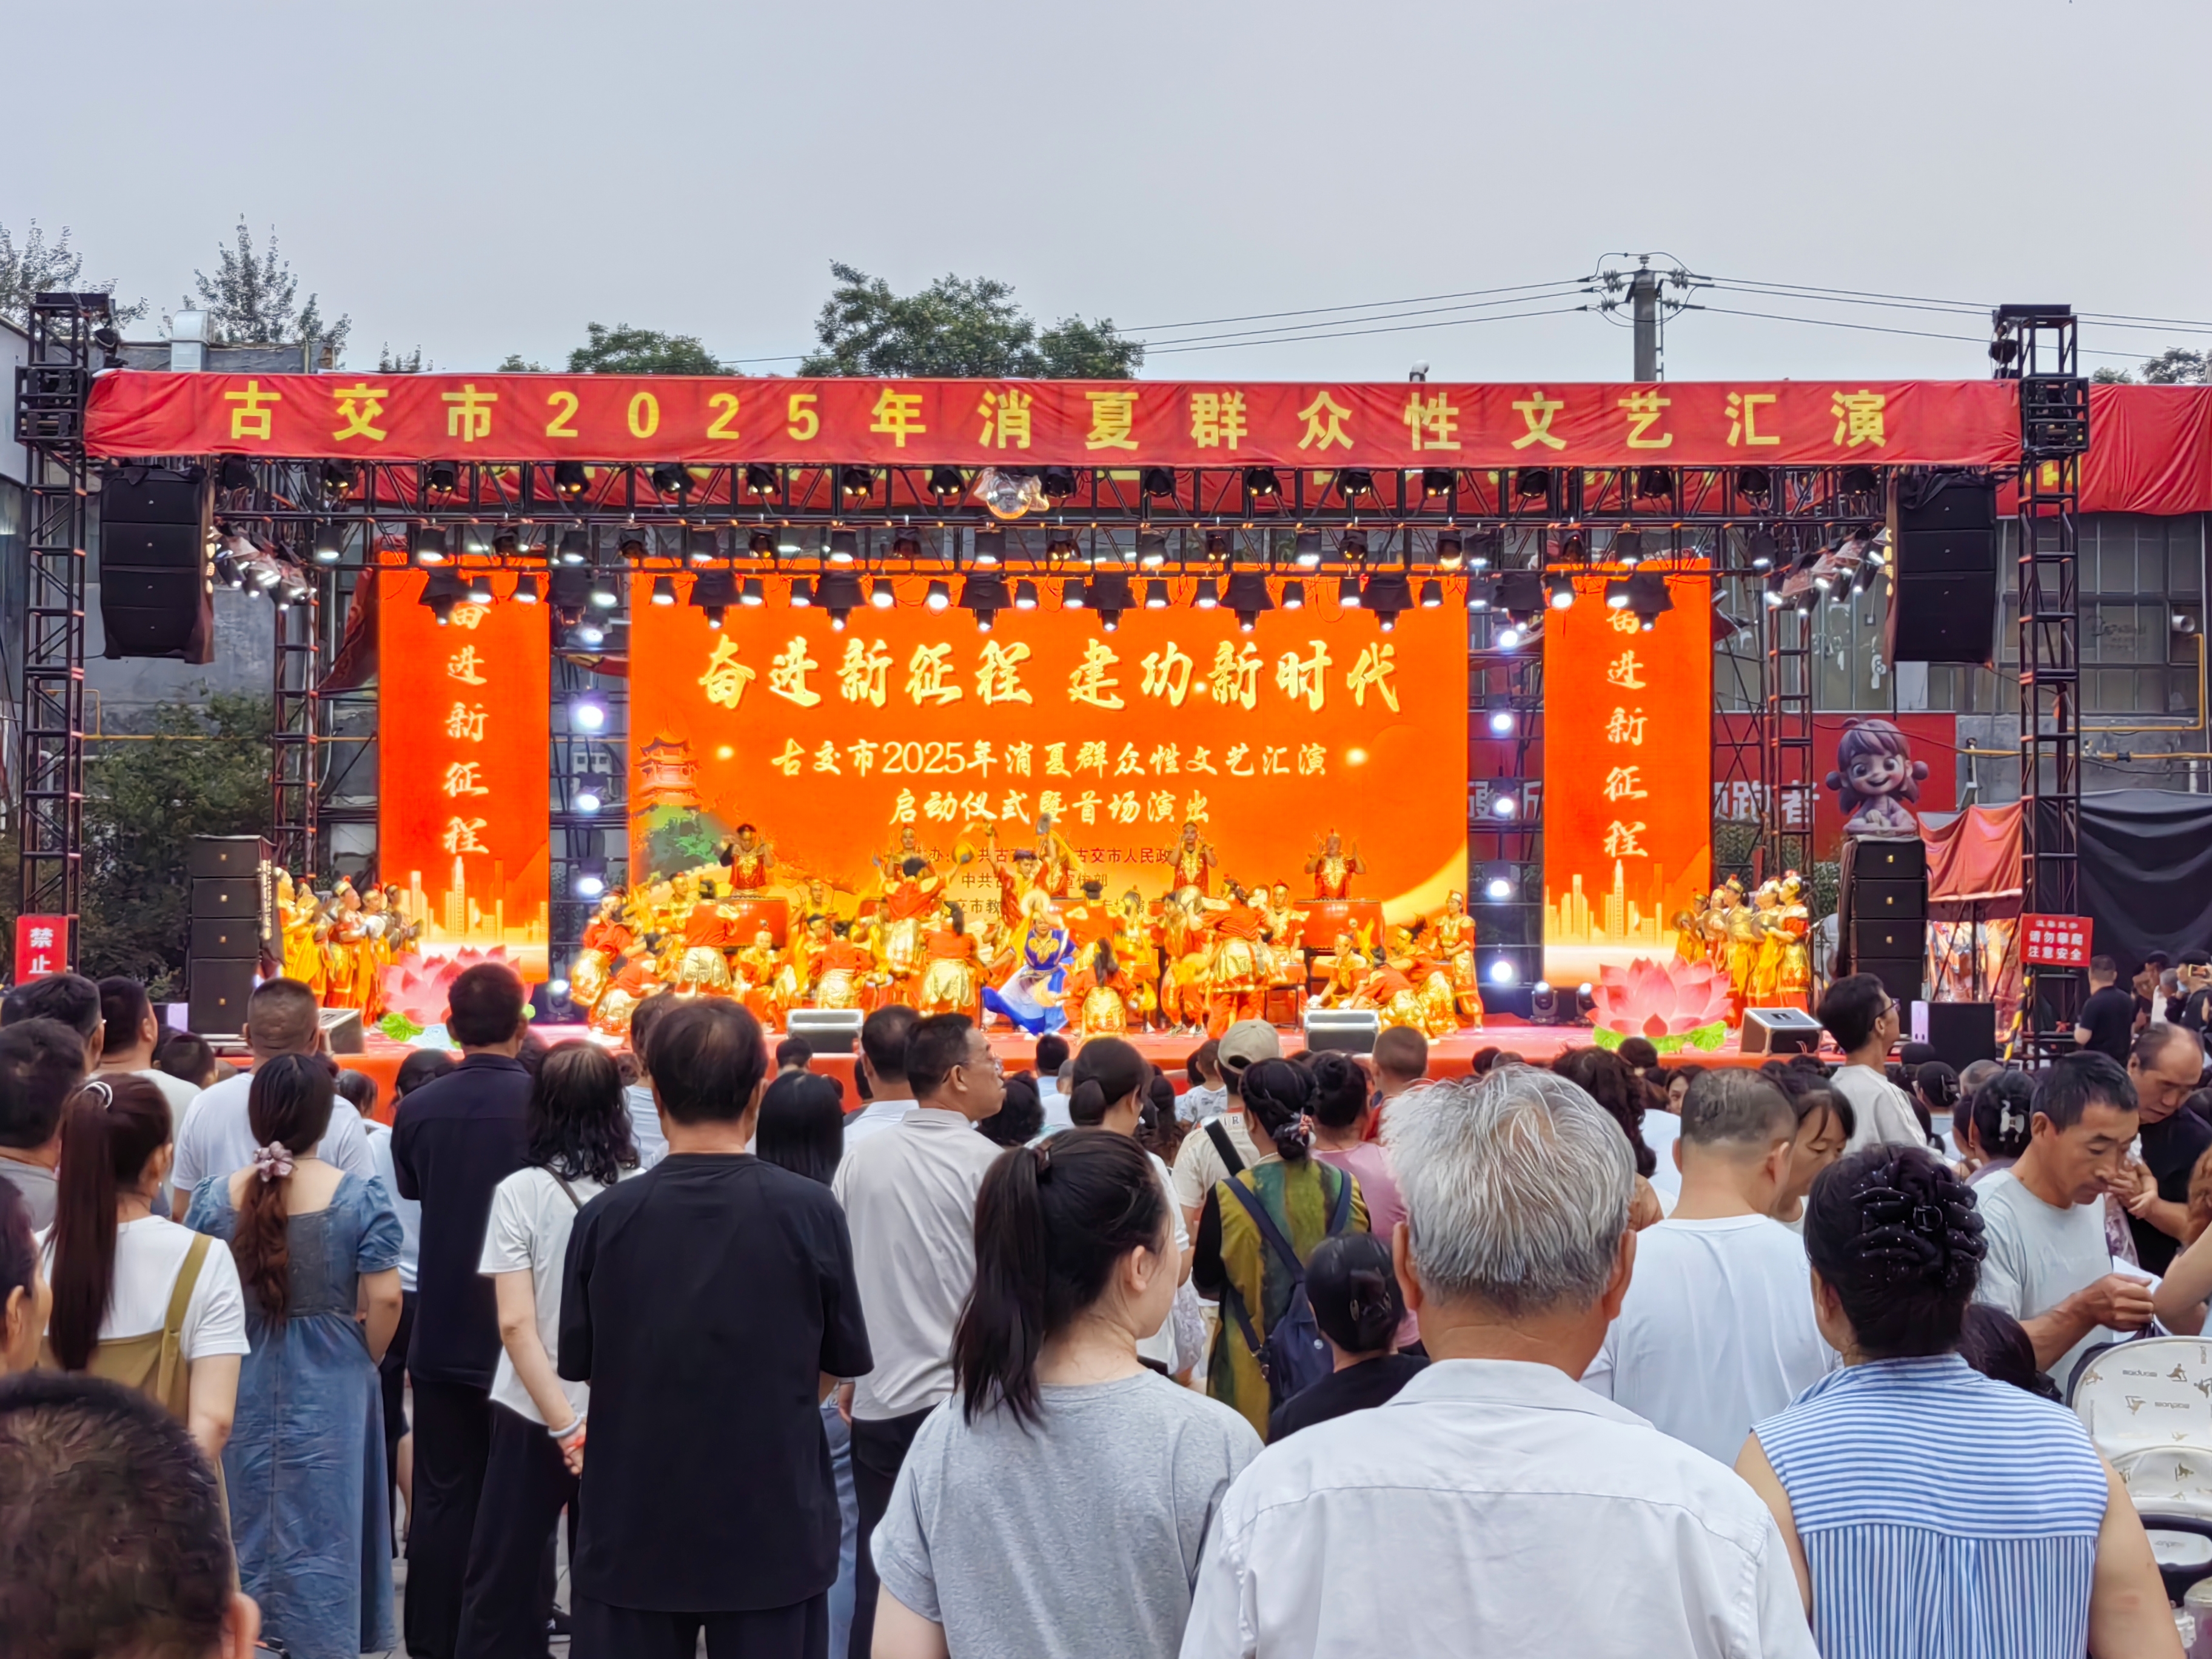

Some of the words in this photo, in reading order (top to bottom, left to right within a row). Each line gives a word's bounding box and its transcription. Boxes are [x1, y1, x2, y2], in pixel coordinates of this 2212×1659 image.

[224, 380, 1886, 451] 古交市2025年消夏群众性文艺汇演
[697, 634, 1034, 710] 奋进新征程
[1067, 638, 1400, 712] 建功新时代
[771, 737, 1327, 779] 古交市2025年消夏群众性文艺汇演
[889, 787, 1210, 826] 启动仪式暨首场演出
[28, 927, 54, 974] 禁止
